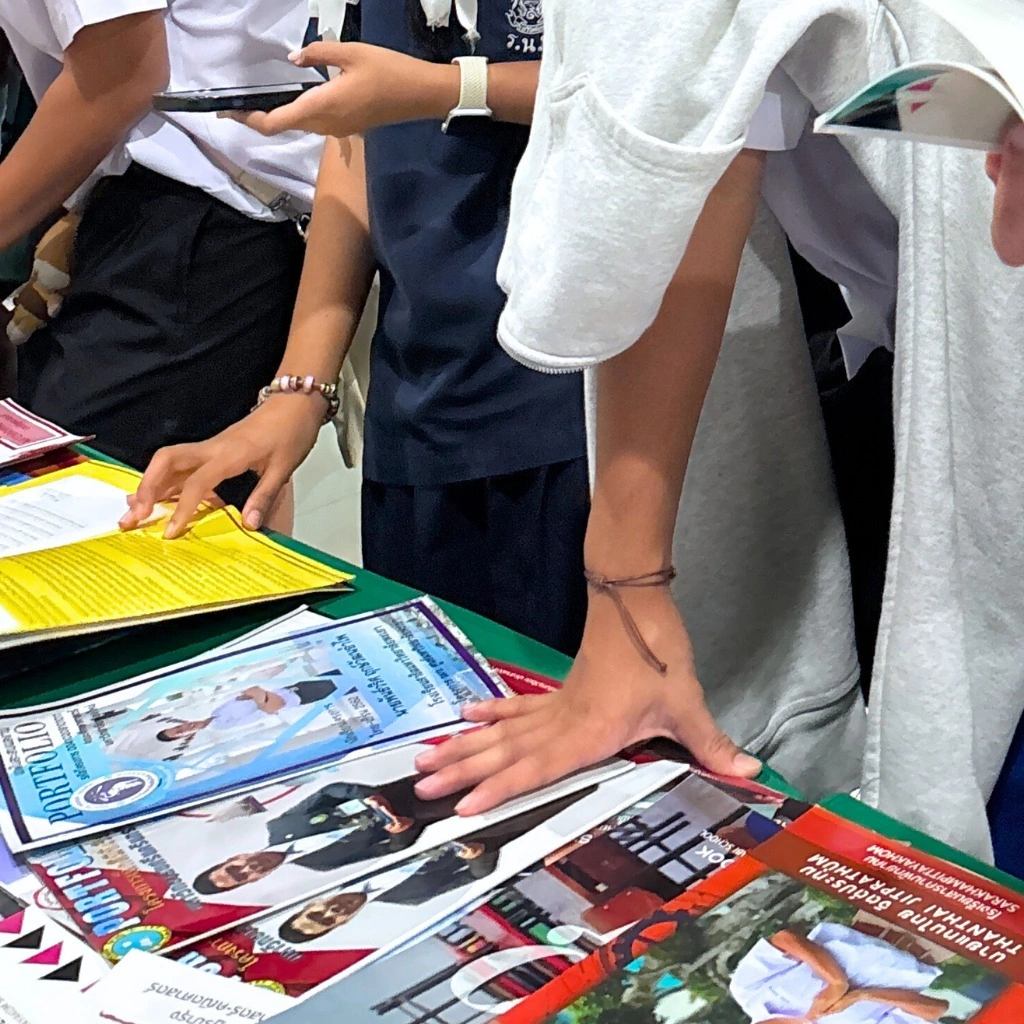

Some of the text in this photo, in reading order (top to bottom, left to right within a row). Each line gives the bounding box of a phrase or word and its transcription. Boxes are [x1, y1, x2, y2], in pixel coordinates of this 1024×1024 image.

[24, 718, 84, 825] PORTFOLIO
[700, 829, 735, 852] SCHOOL
[866, 845, 1020, 913] SARAKHAMPITTAYAKHOM
[807, 854, 1023, 955] THANTHAI JITPRATHUM
